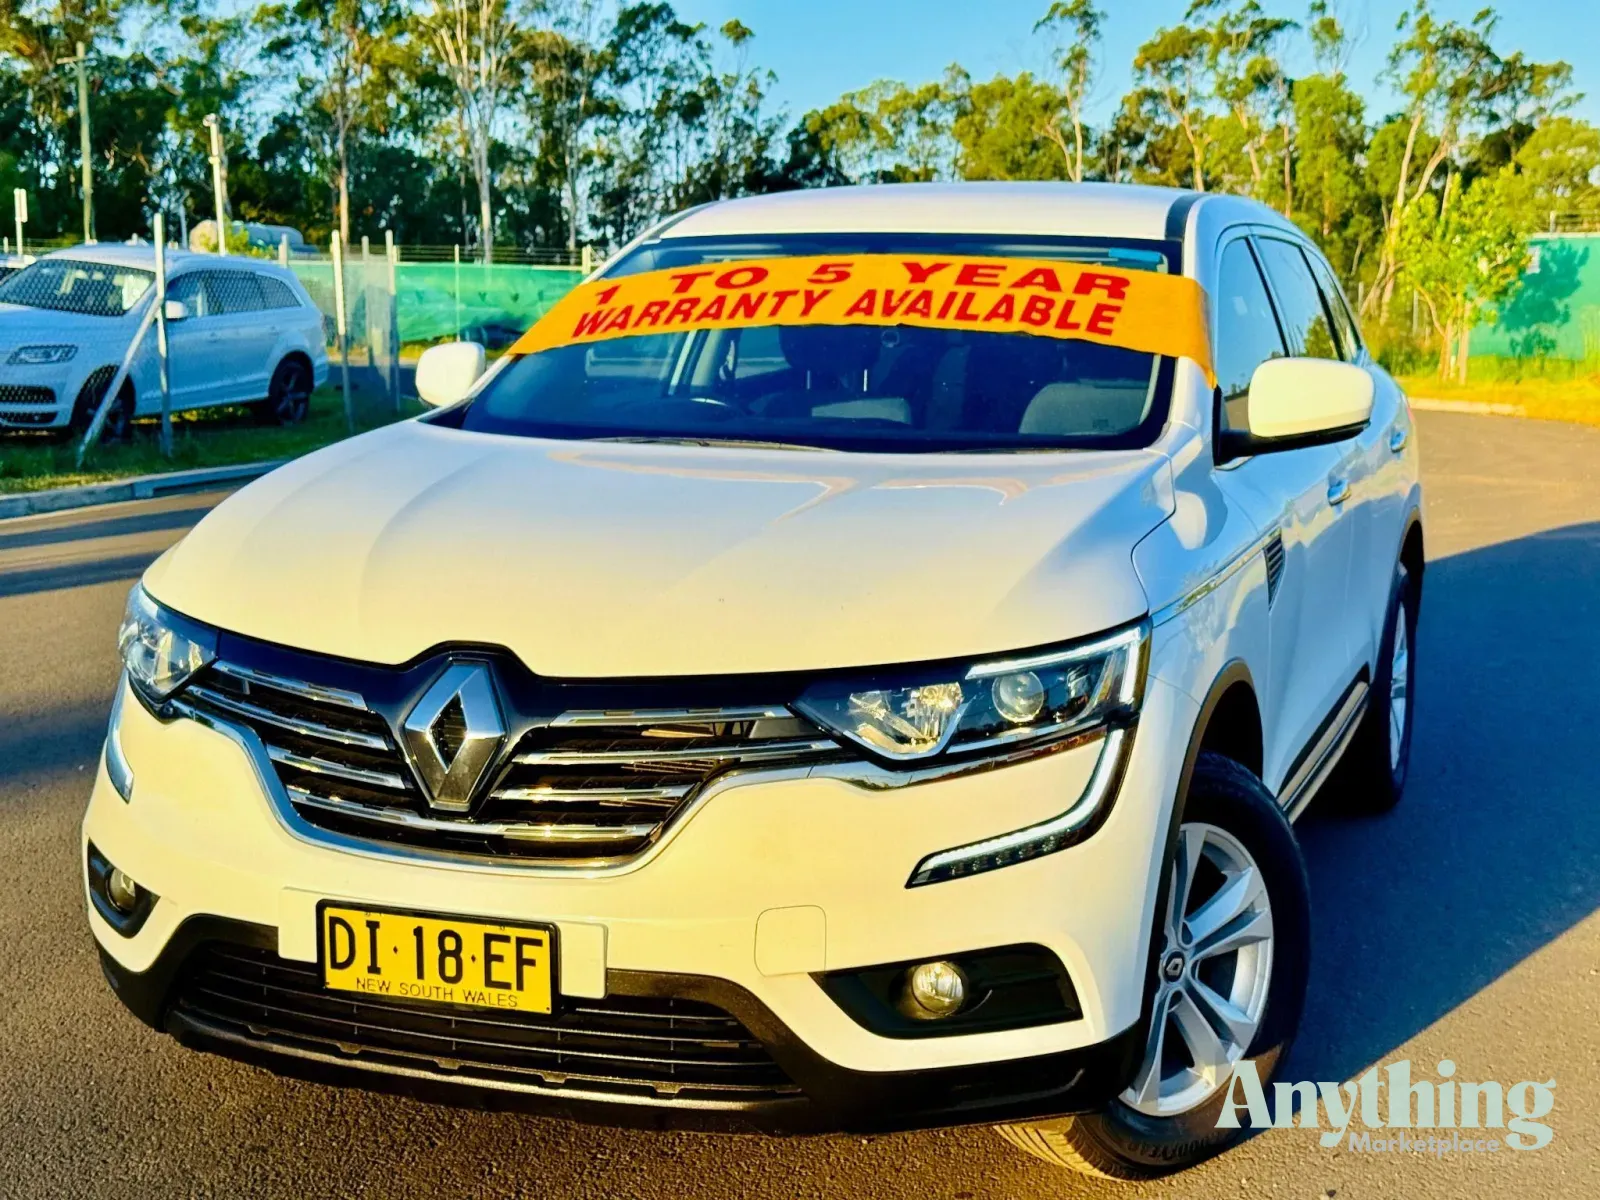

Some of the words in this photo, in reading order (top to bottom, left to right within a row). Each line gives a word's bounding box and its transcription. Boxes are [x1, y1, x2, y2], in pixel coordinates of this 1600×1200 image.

[594, 285, 620, 305] 1
[669, 265, 769, 294] TO
[807, 262, 853, 285] 5
[901, 261, 1131, 300] YEAR
[571, 289, 831, 338] WARRANTY
[844, 289, 1122, 336] AVAILABLE
[356, 977, 391, 993] NEW
[399, 982, 453, 1000] SOUTH
[463, 989, 518, 1007] WALES
